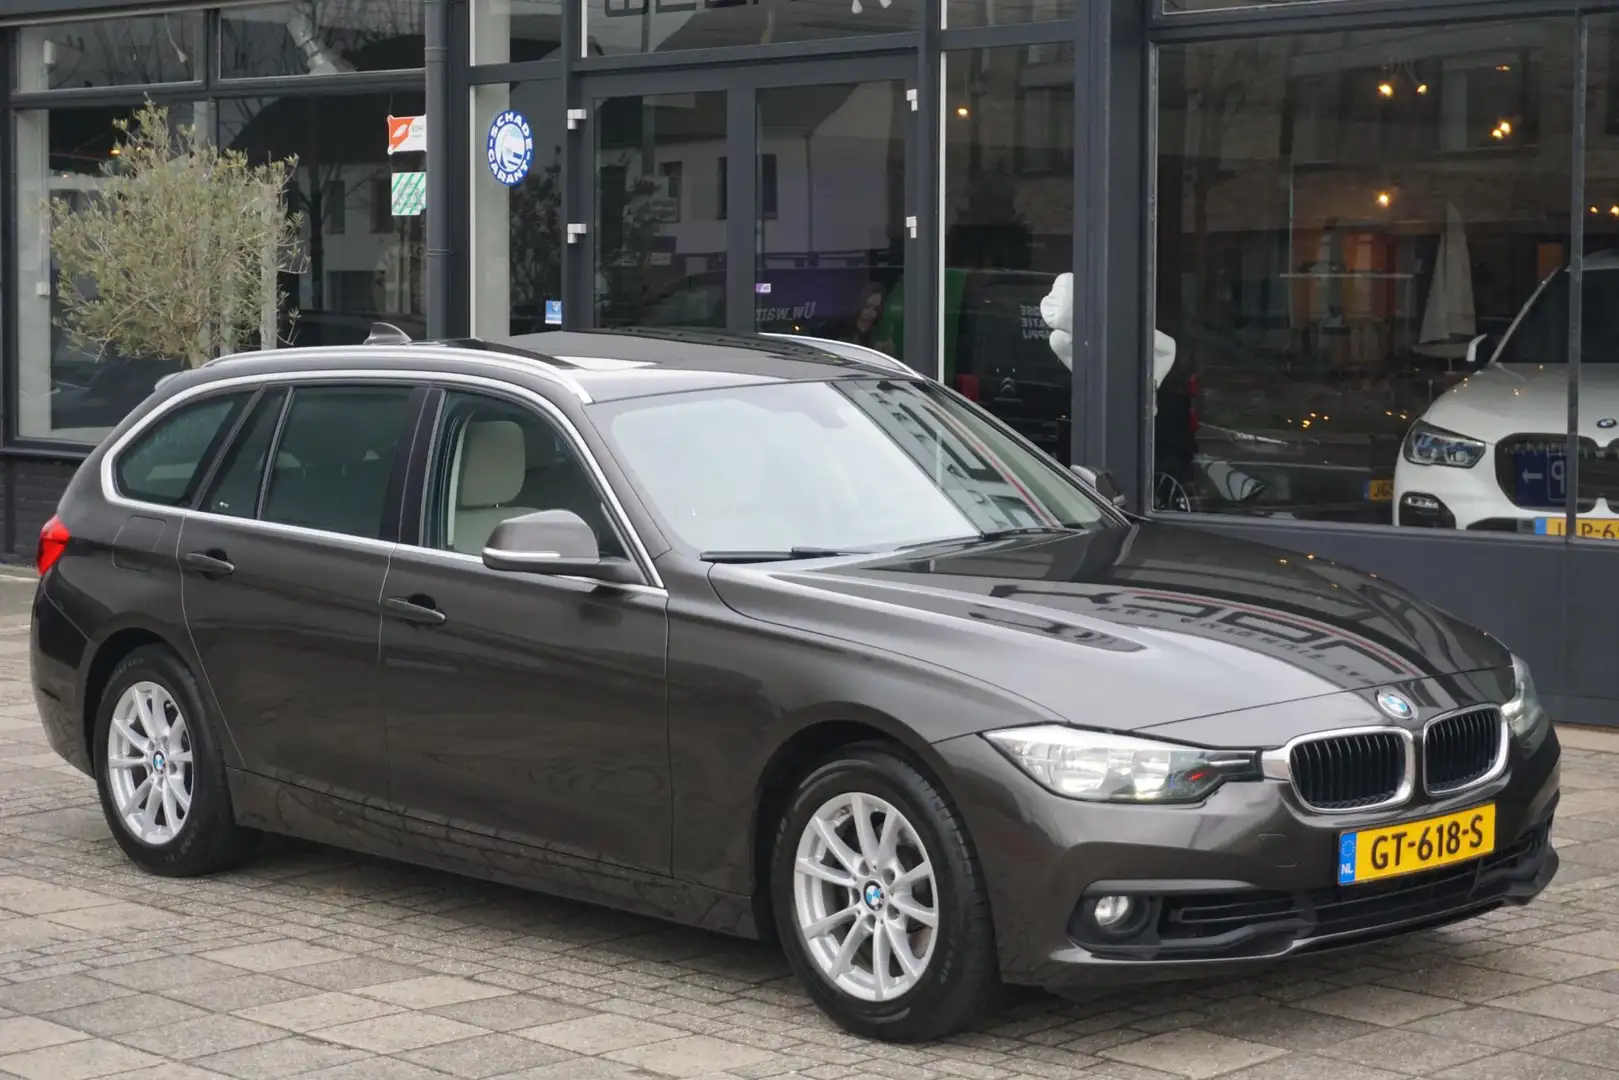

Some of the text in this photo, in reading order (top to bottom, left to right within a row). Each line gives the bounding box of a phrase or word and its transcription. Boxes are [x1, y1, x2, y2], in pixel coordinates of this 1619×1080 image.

[490, 111, 532, 150] SCHADE
[488, 148, 528, 184] GARANT
[1371, 814, 1484, 870] GT-618-S
[1341, 862, 1353, 875] NL
